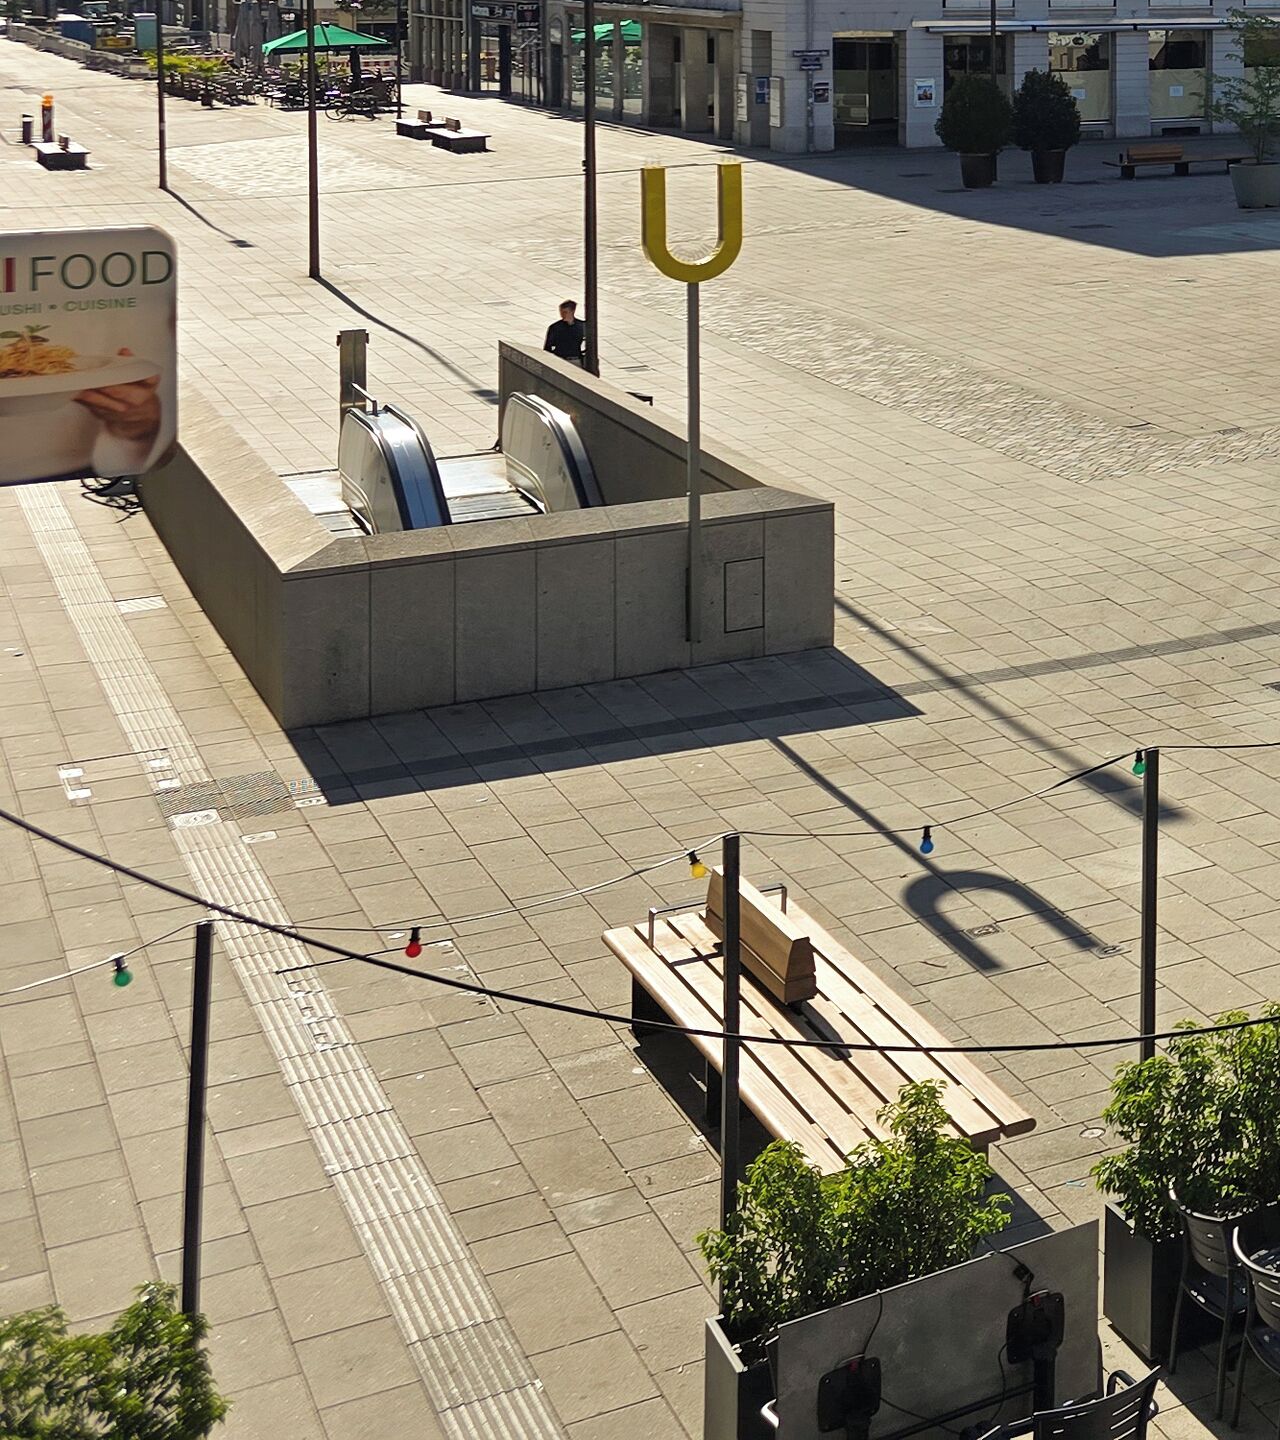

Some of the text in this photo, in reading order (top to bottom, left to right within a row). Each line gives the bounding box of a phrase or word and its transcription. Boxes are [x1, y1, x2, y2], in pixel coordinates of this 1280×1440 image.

[641, 164, 743, 283] U
[0, 250, 174, 293] I FOOD
[0, 297, 137, 316] USHI CUISINE
